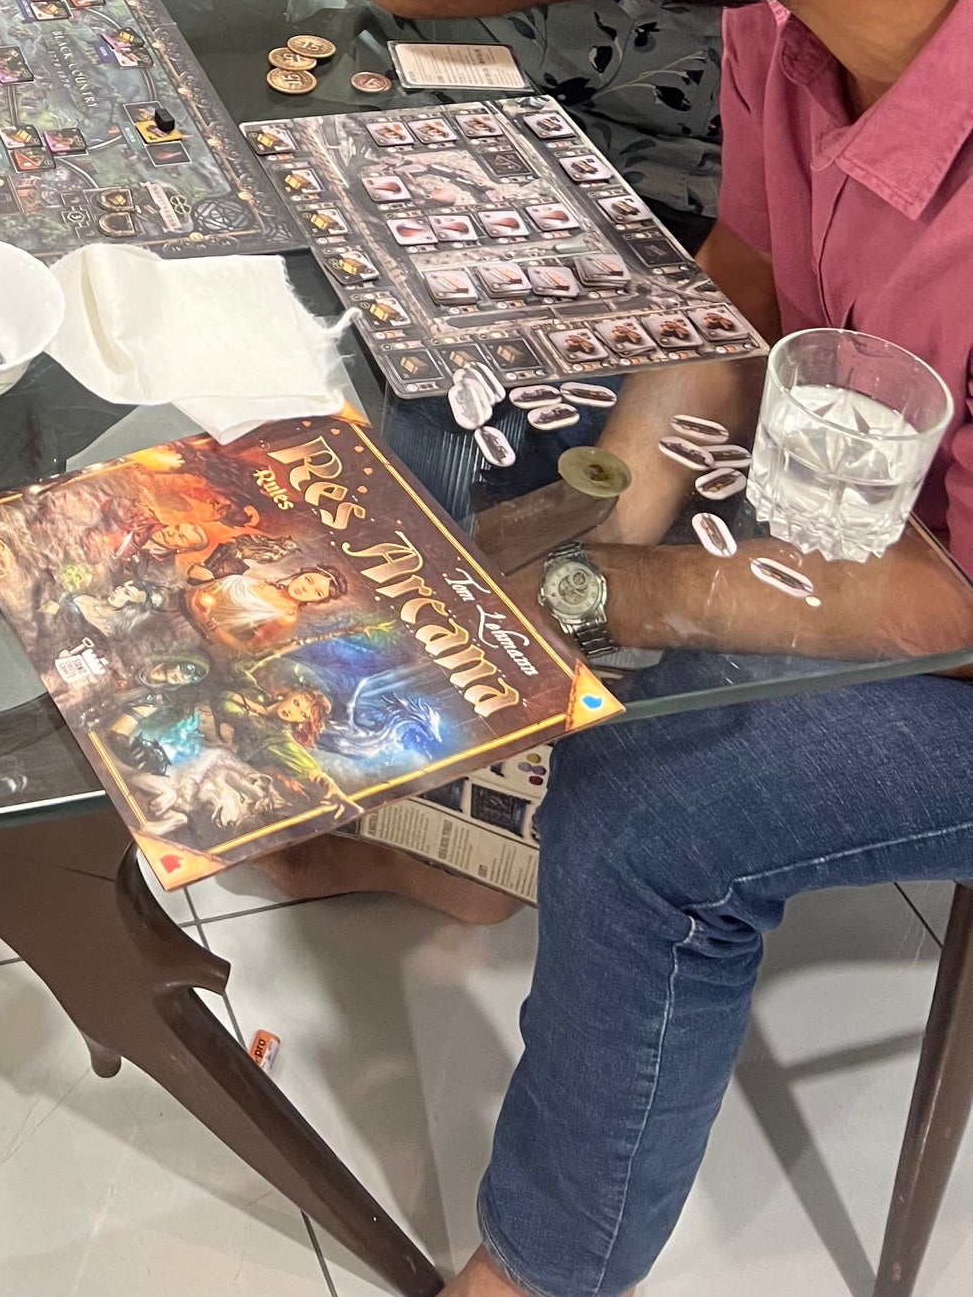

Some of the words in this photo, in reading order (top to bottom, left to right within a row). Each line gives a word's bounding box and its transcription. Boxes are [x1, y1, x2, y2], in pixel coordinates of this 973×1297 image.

[52, 30, 74, 60] BLACK
[68, 63, 99, 108] COUNTRY
[301, 41, 321, 51] 15
[281, 74, 302, 85] 15
[253, 466, 295, 511] Rules
[267, 435, 366, 530] Res
[342, 530, 520, 718] Arcana
[442, 567, 491, 603] Tom
[476, 604, 539, 677] Lehmann
